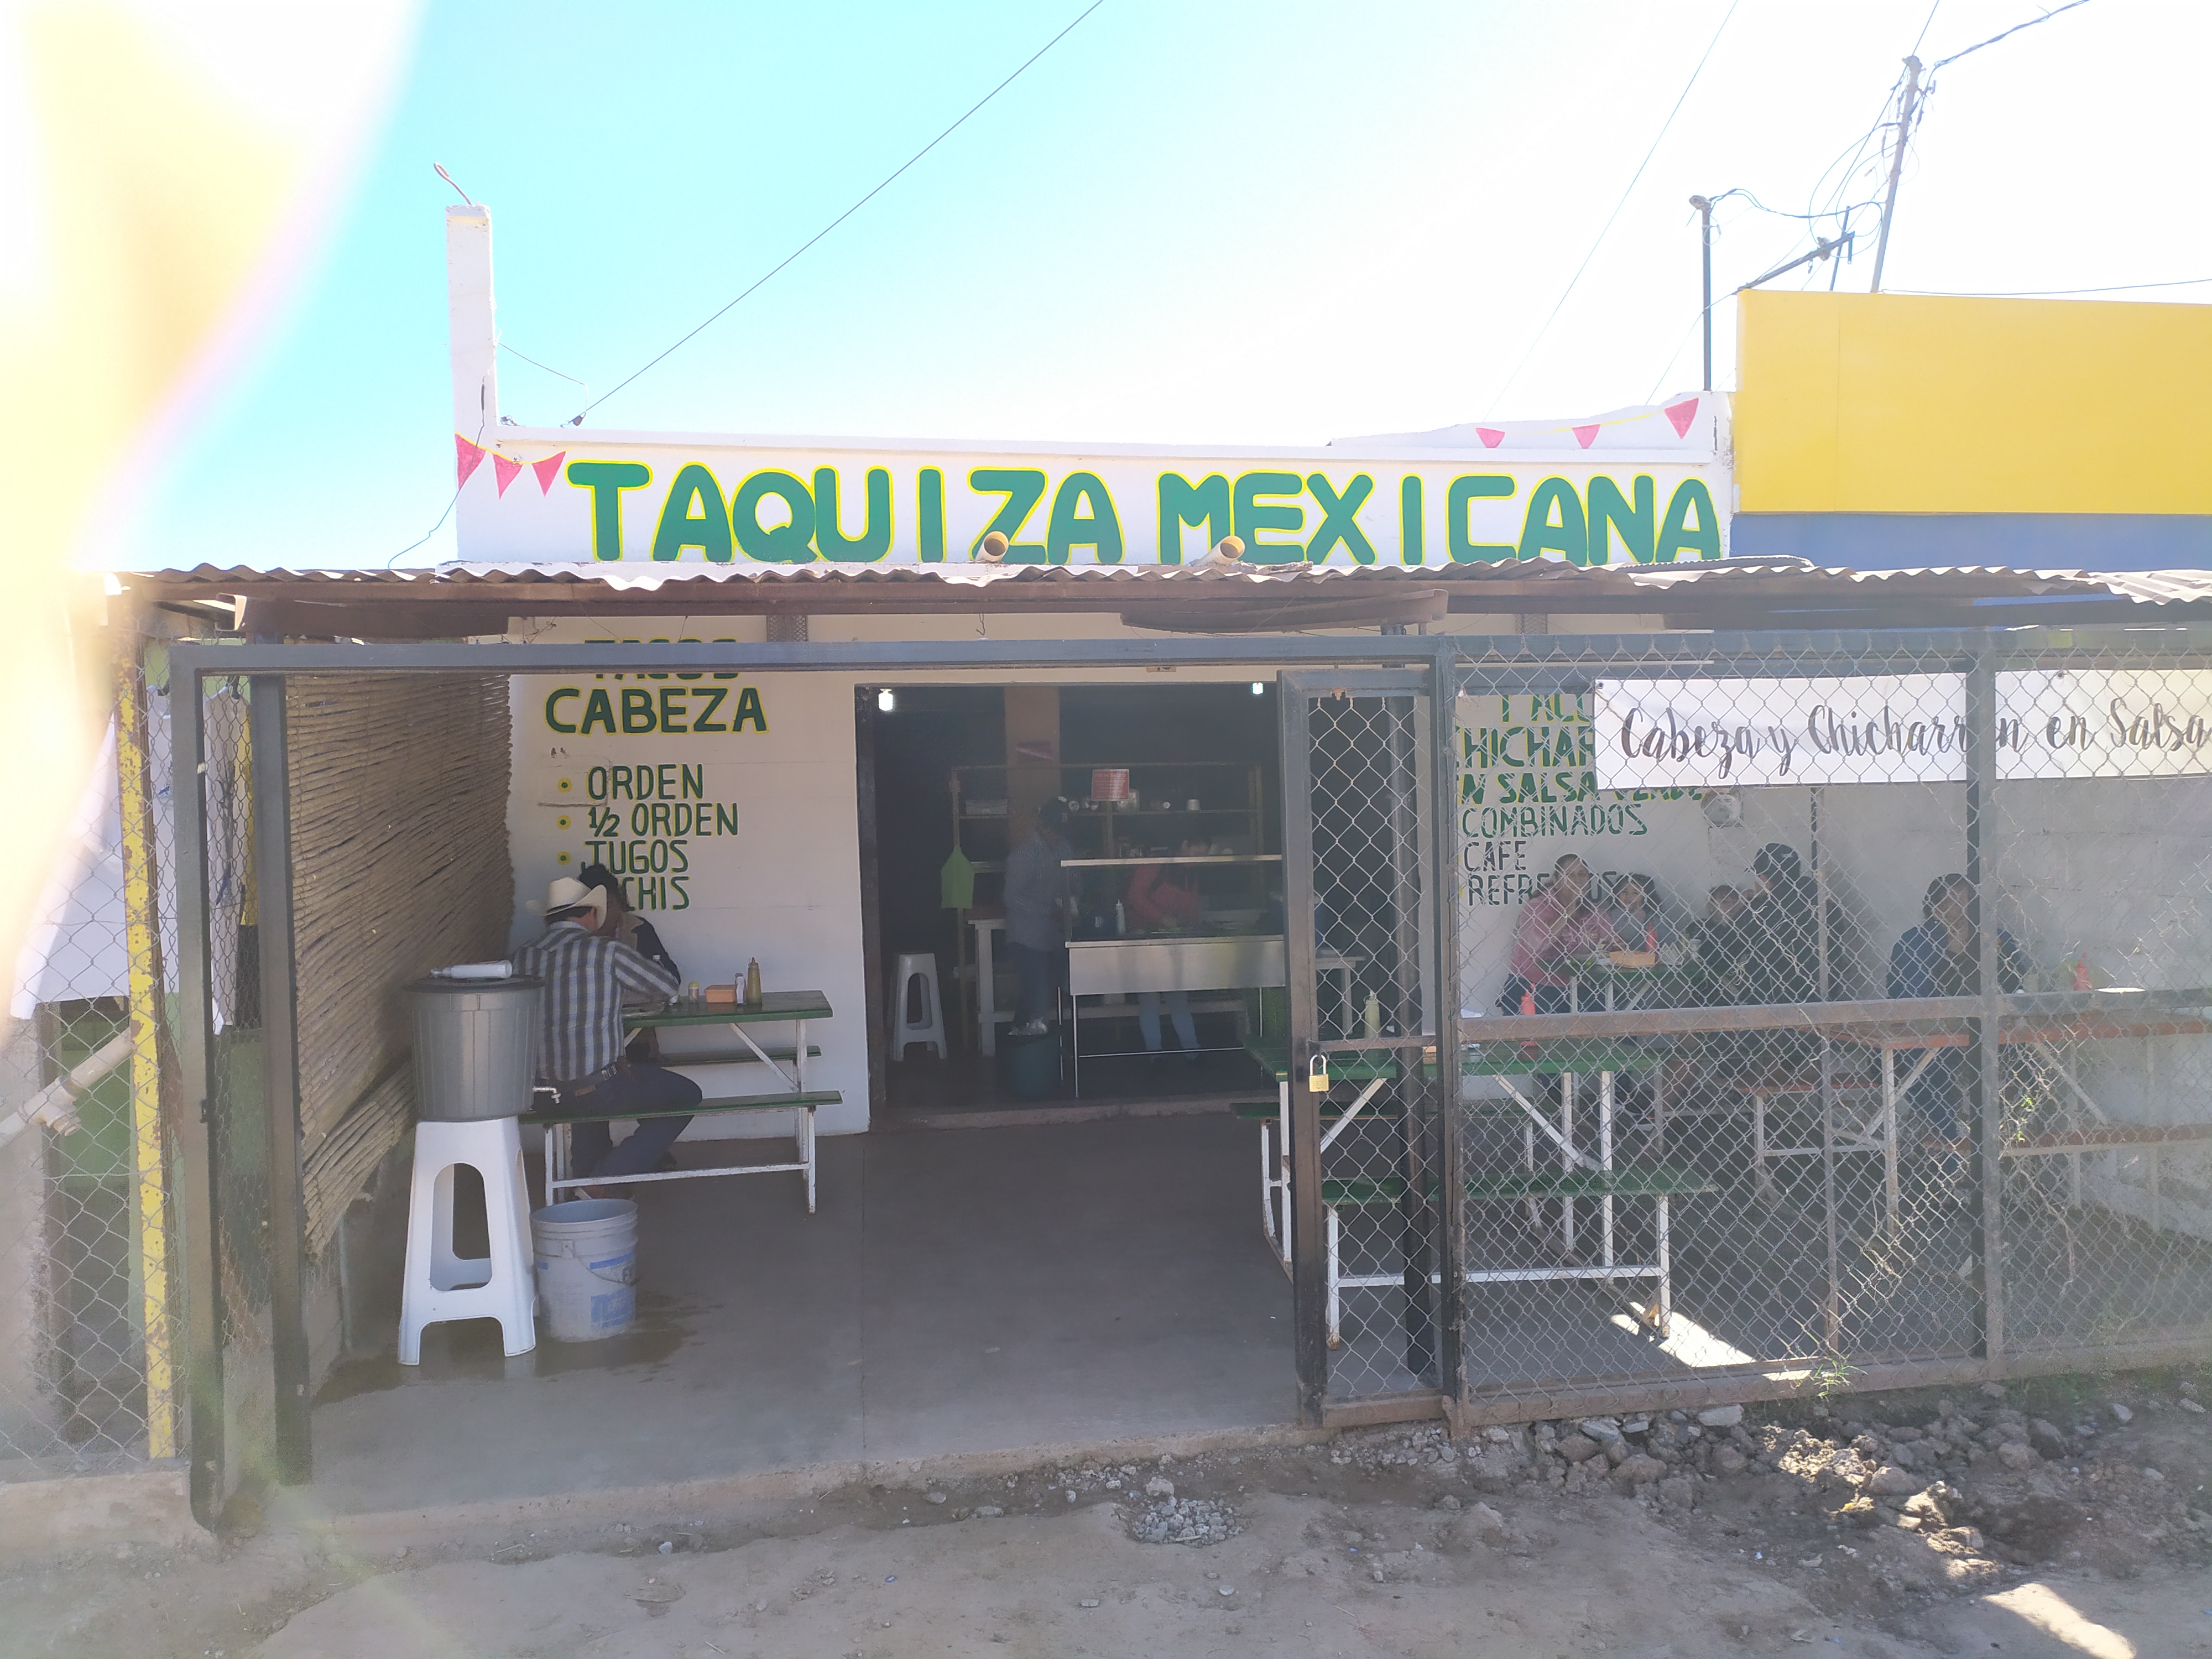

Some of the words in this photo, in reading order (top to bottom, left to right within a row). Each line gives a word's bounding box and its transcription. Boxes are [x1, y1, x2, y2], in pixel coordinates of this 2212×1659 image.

[565, 461, 1125, 565] TAQUIZA
[1157, 470, 1725, 566] MEXICANA
[545, 687, 769, 737] CABEZA
[1454, 725, 1595, 769] HICHAR
[1621, 707, 1760, 780] Cabeza
[1767, 726, 1798, 776] y
[1808, 704, 2028, 758] Chicharrn
[2046, 716, 2096, 750] en
[2109, 696, 2211, 752] Salsa
[587, 763, 704, 801] ORDEN
[1496, 770, 1601, 804] SALSA
[630, 802, 739, 837] ORDEN
[1462, 802, 1648, 838] COMBINADOS
[1463, 840, 1527, 872] CAFE
